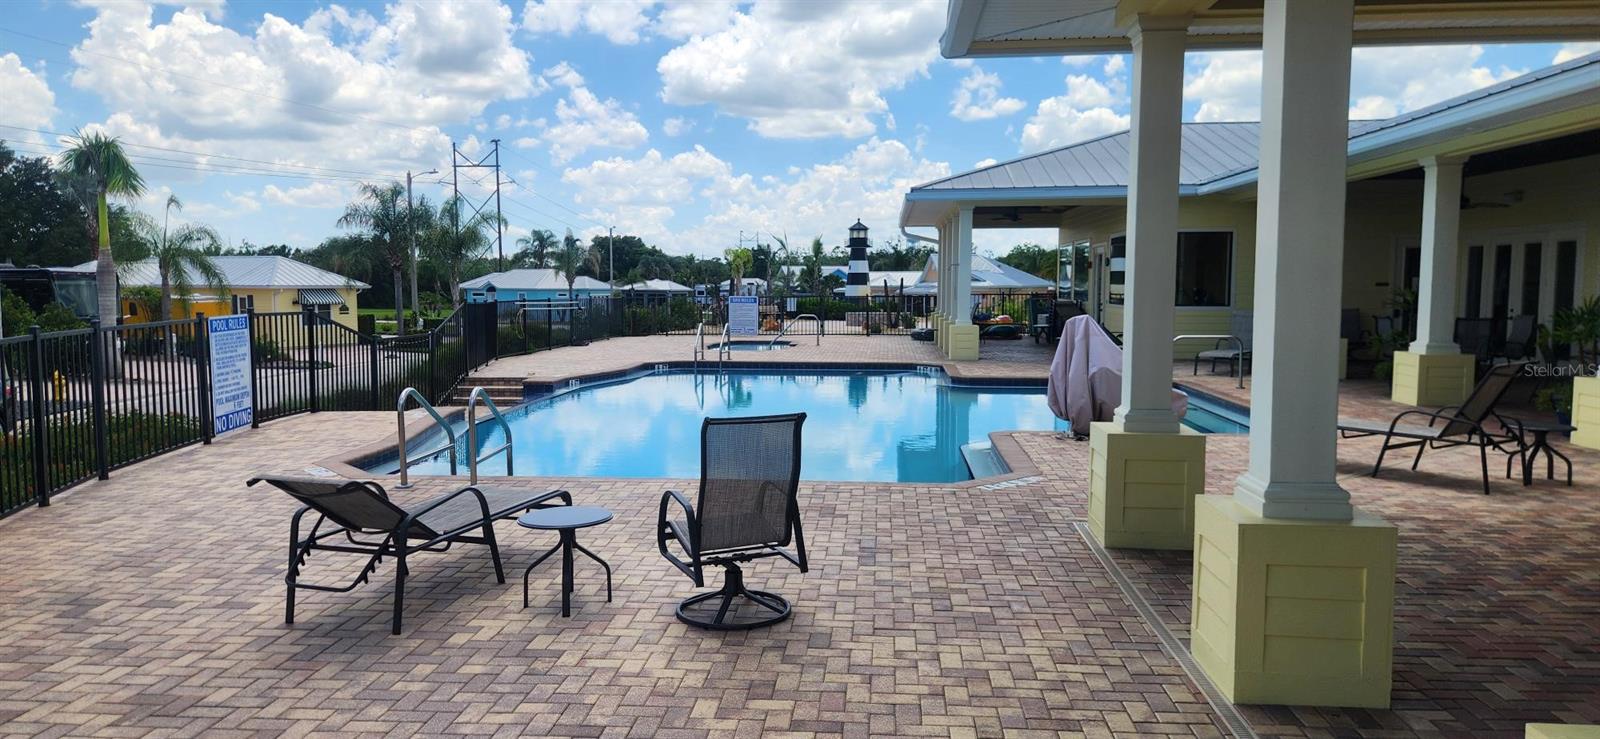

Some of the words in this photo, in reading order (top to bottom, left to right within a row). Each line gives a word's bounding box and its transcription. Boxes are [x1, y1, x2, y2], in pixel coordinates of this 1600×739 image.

[212, 319, 228, 332] POOL
[228, 317, 246, 330] RULES
[216, 415, 227, 432] NO
[228, 408, 251, 429] DIVING
